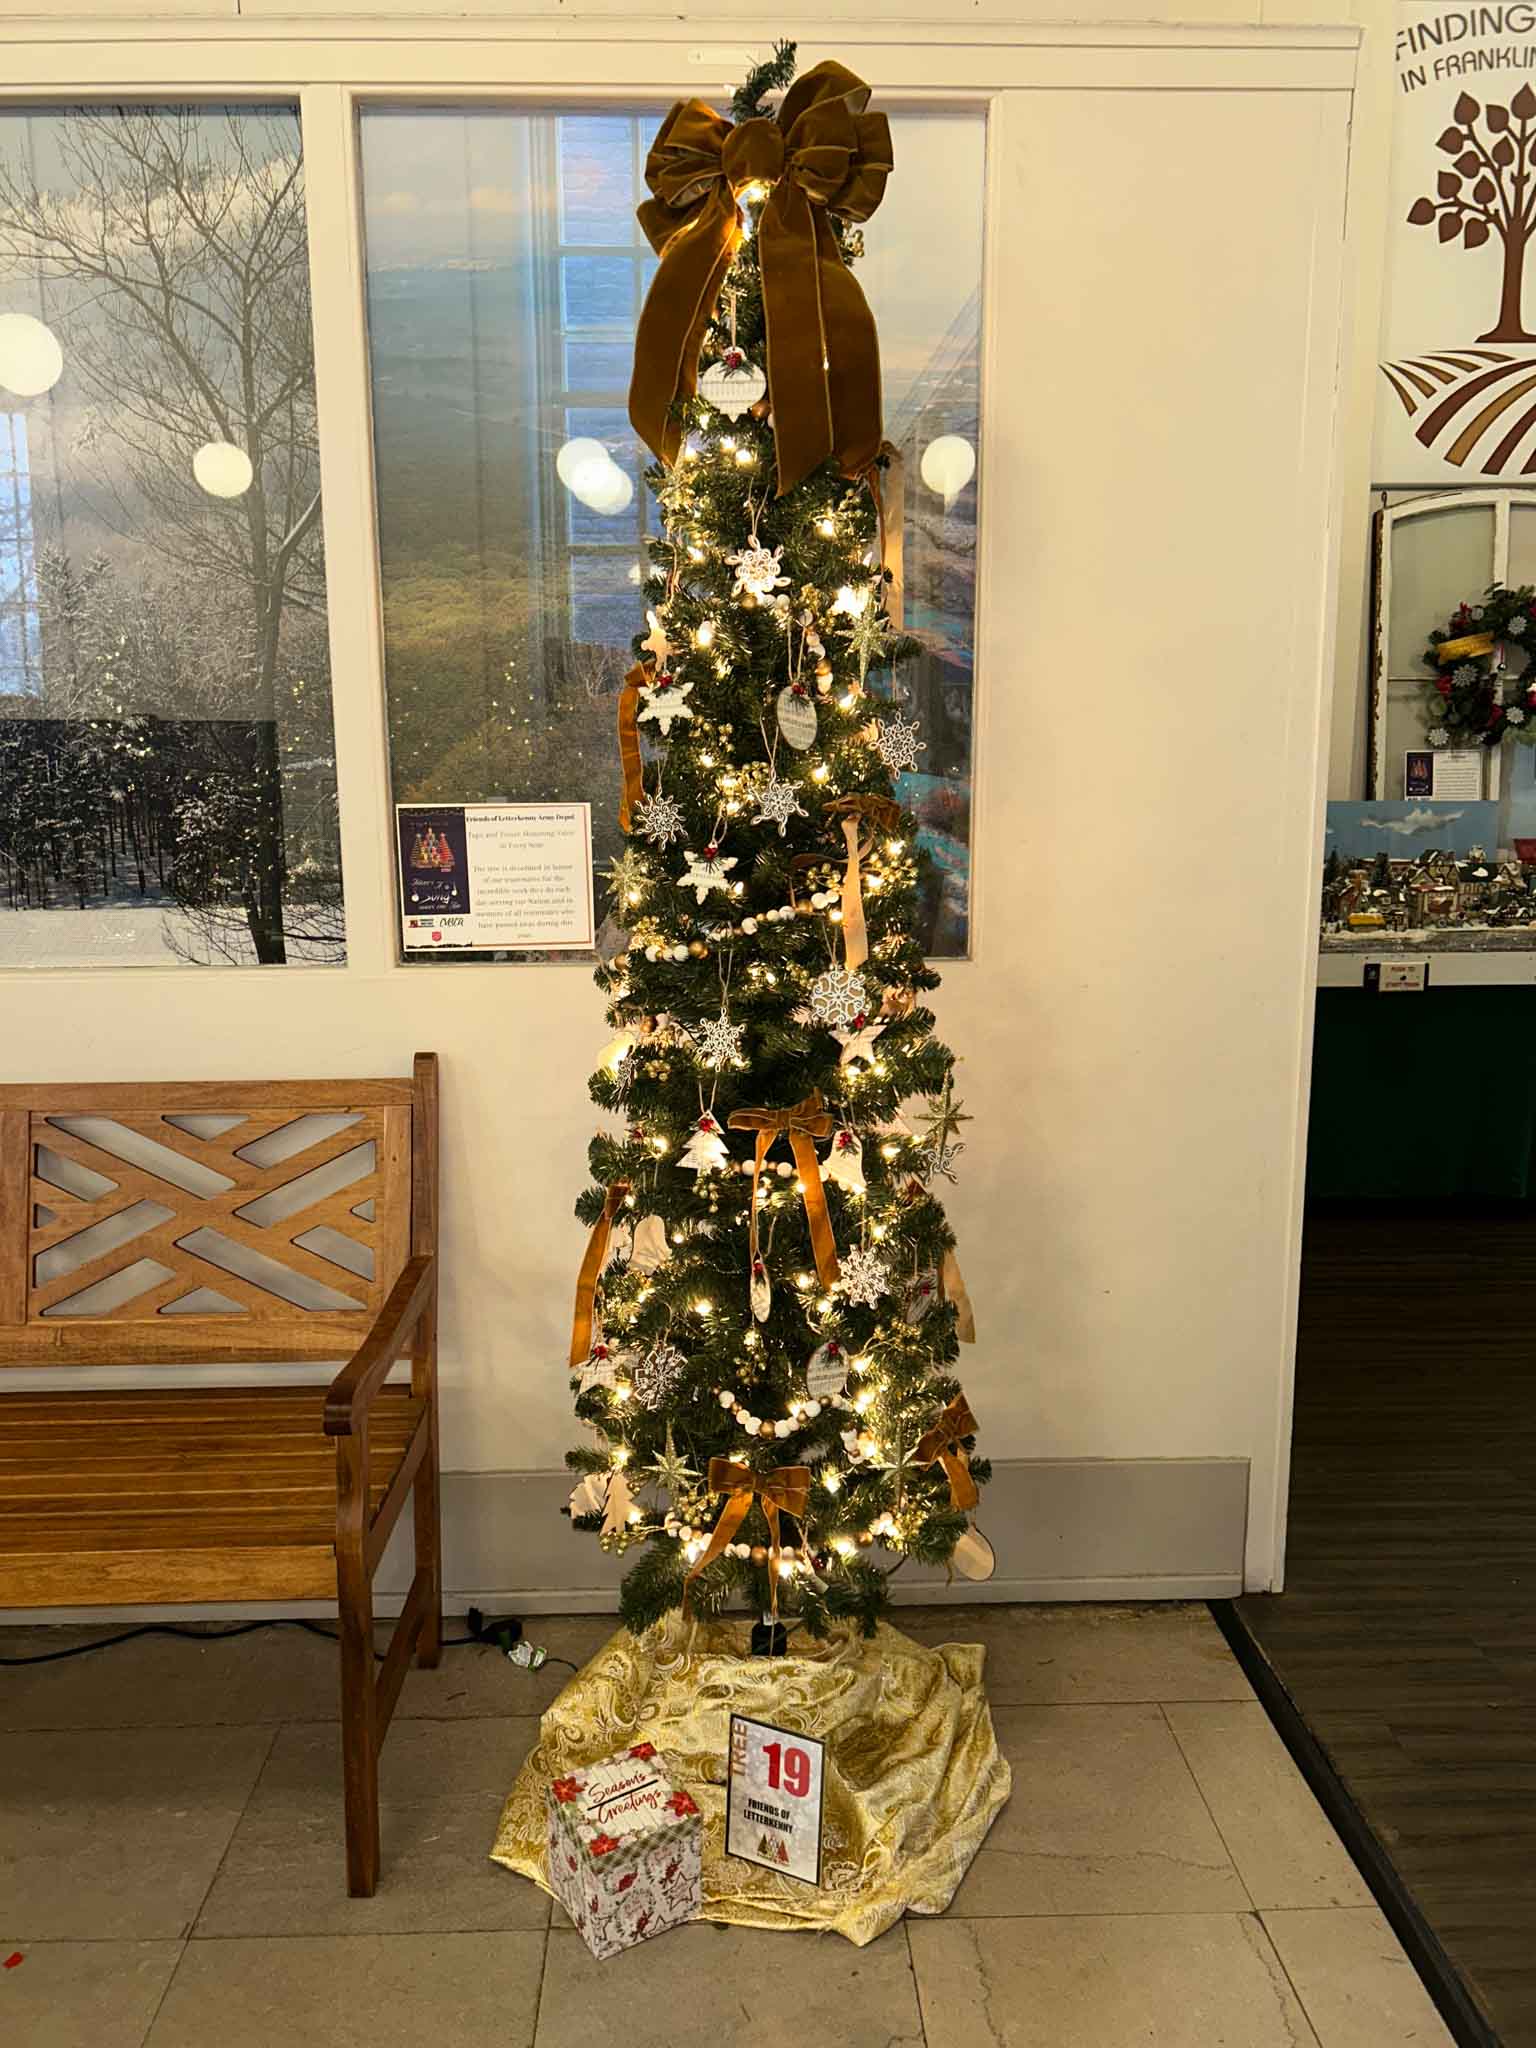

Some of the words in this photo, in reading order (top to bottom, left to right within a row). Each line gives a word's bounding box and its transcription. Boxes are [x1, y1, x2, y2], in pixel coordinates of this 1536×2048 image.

[1395, 4, 1536, 62] FINDING
[1401, 65, 1427, 93] IN
[588, 1770, 647, 1804] Season's
[762, 1742, 811, 1798] 19
[598, 1789, 662, 1825] Greetings
[743, 1809, 793, 1834] LETTERKENNY
[748, 1797, 779, 1817] FRIENDS
[781, 1809, 790, 1820] OF
